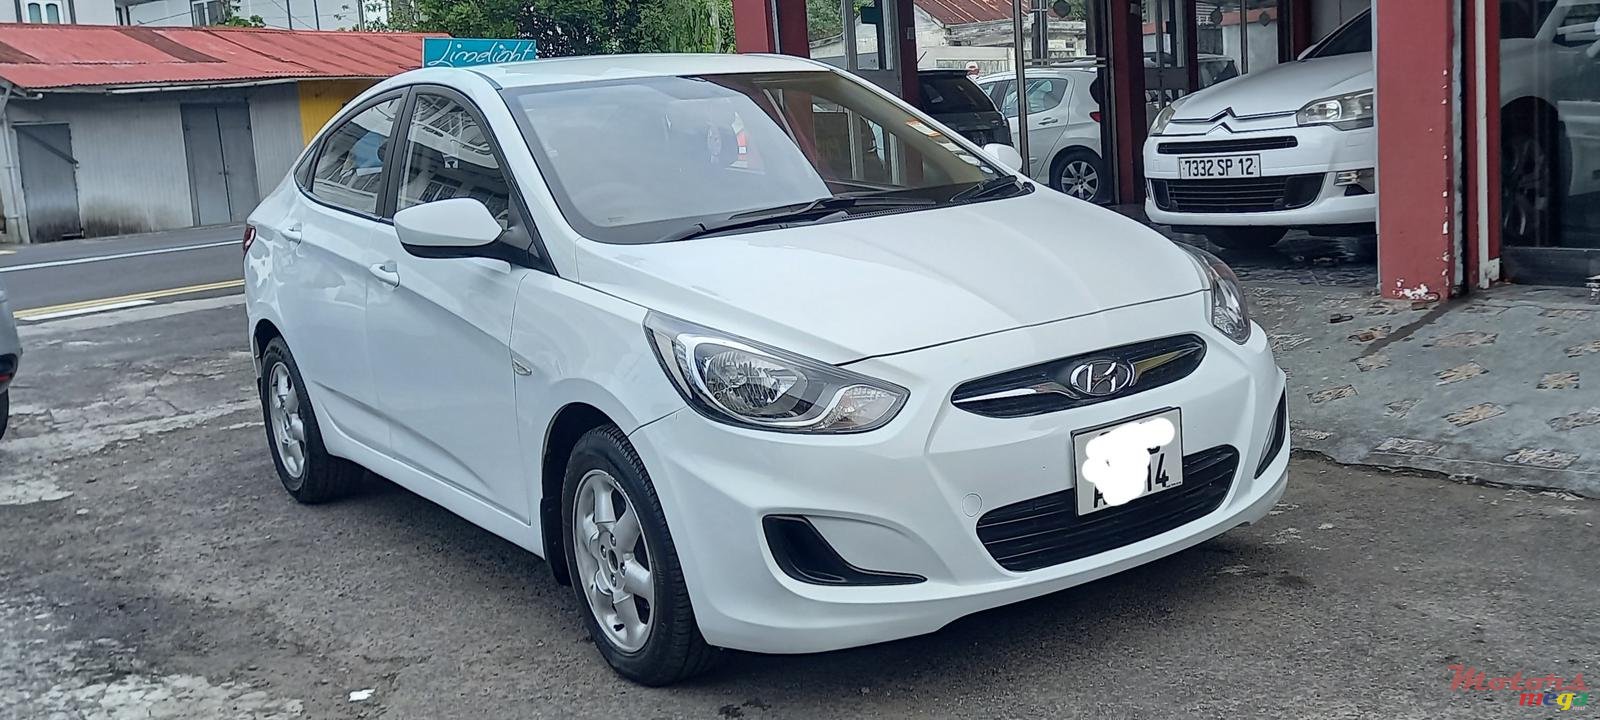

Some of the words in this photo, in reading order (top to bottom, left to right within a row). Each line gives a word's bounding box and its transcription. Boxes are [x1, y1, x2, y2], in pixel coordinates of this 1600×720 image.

[427, 41, 533, 68] Limelight
[1184, 160, 1214, 177] 7332
[1217, 158, 1233, 176] SP
[1238, 157, 1255, 175] 12
